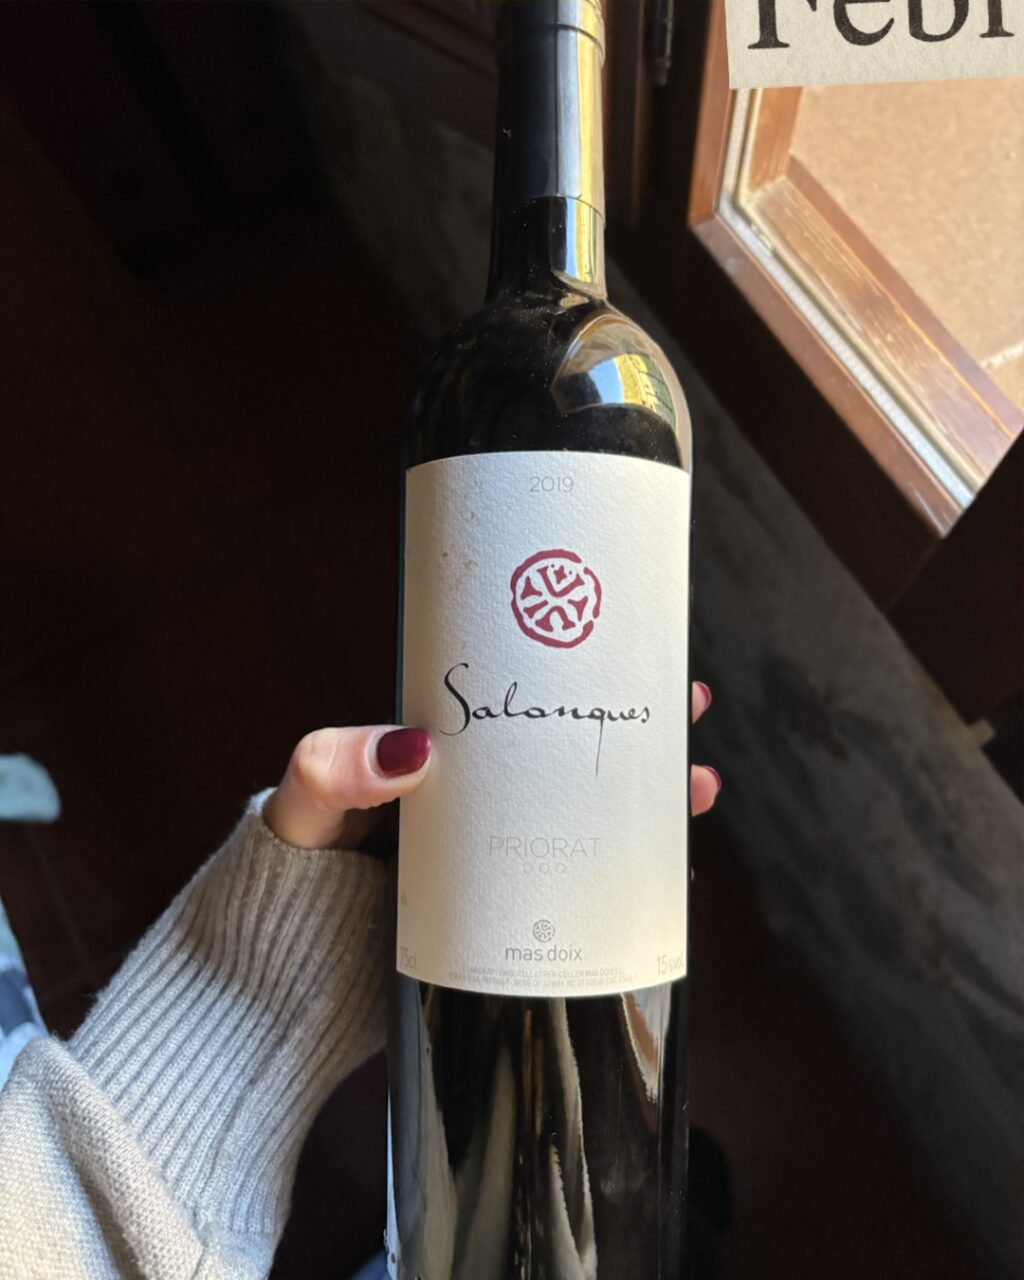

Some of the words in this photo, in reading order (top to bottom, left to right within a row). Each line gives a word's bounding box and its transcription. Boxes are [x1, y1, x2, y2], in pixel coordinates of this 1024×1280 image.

[529, 476, 574, 493] 2019
[439, 662, 650, 776] Salanques
[488, 836, 601, 857] PRIORAT
[505, 946, 542, 961] mas
[547, 944, 582, 961] doix
